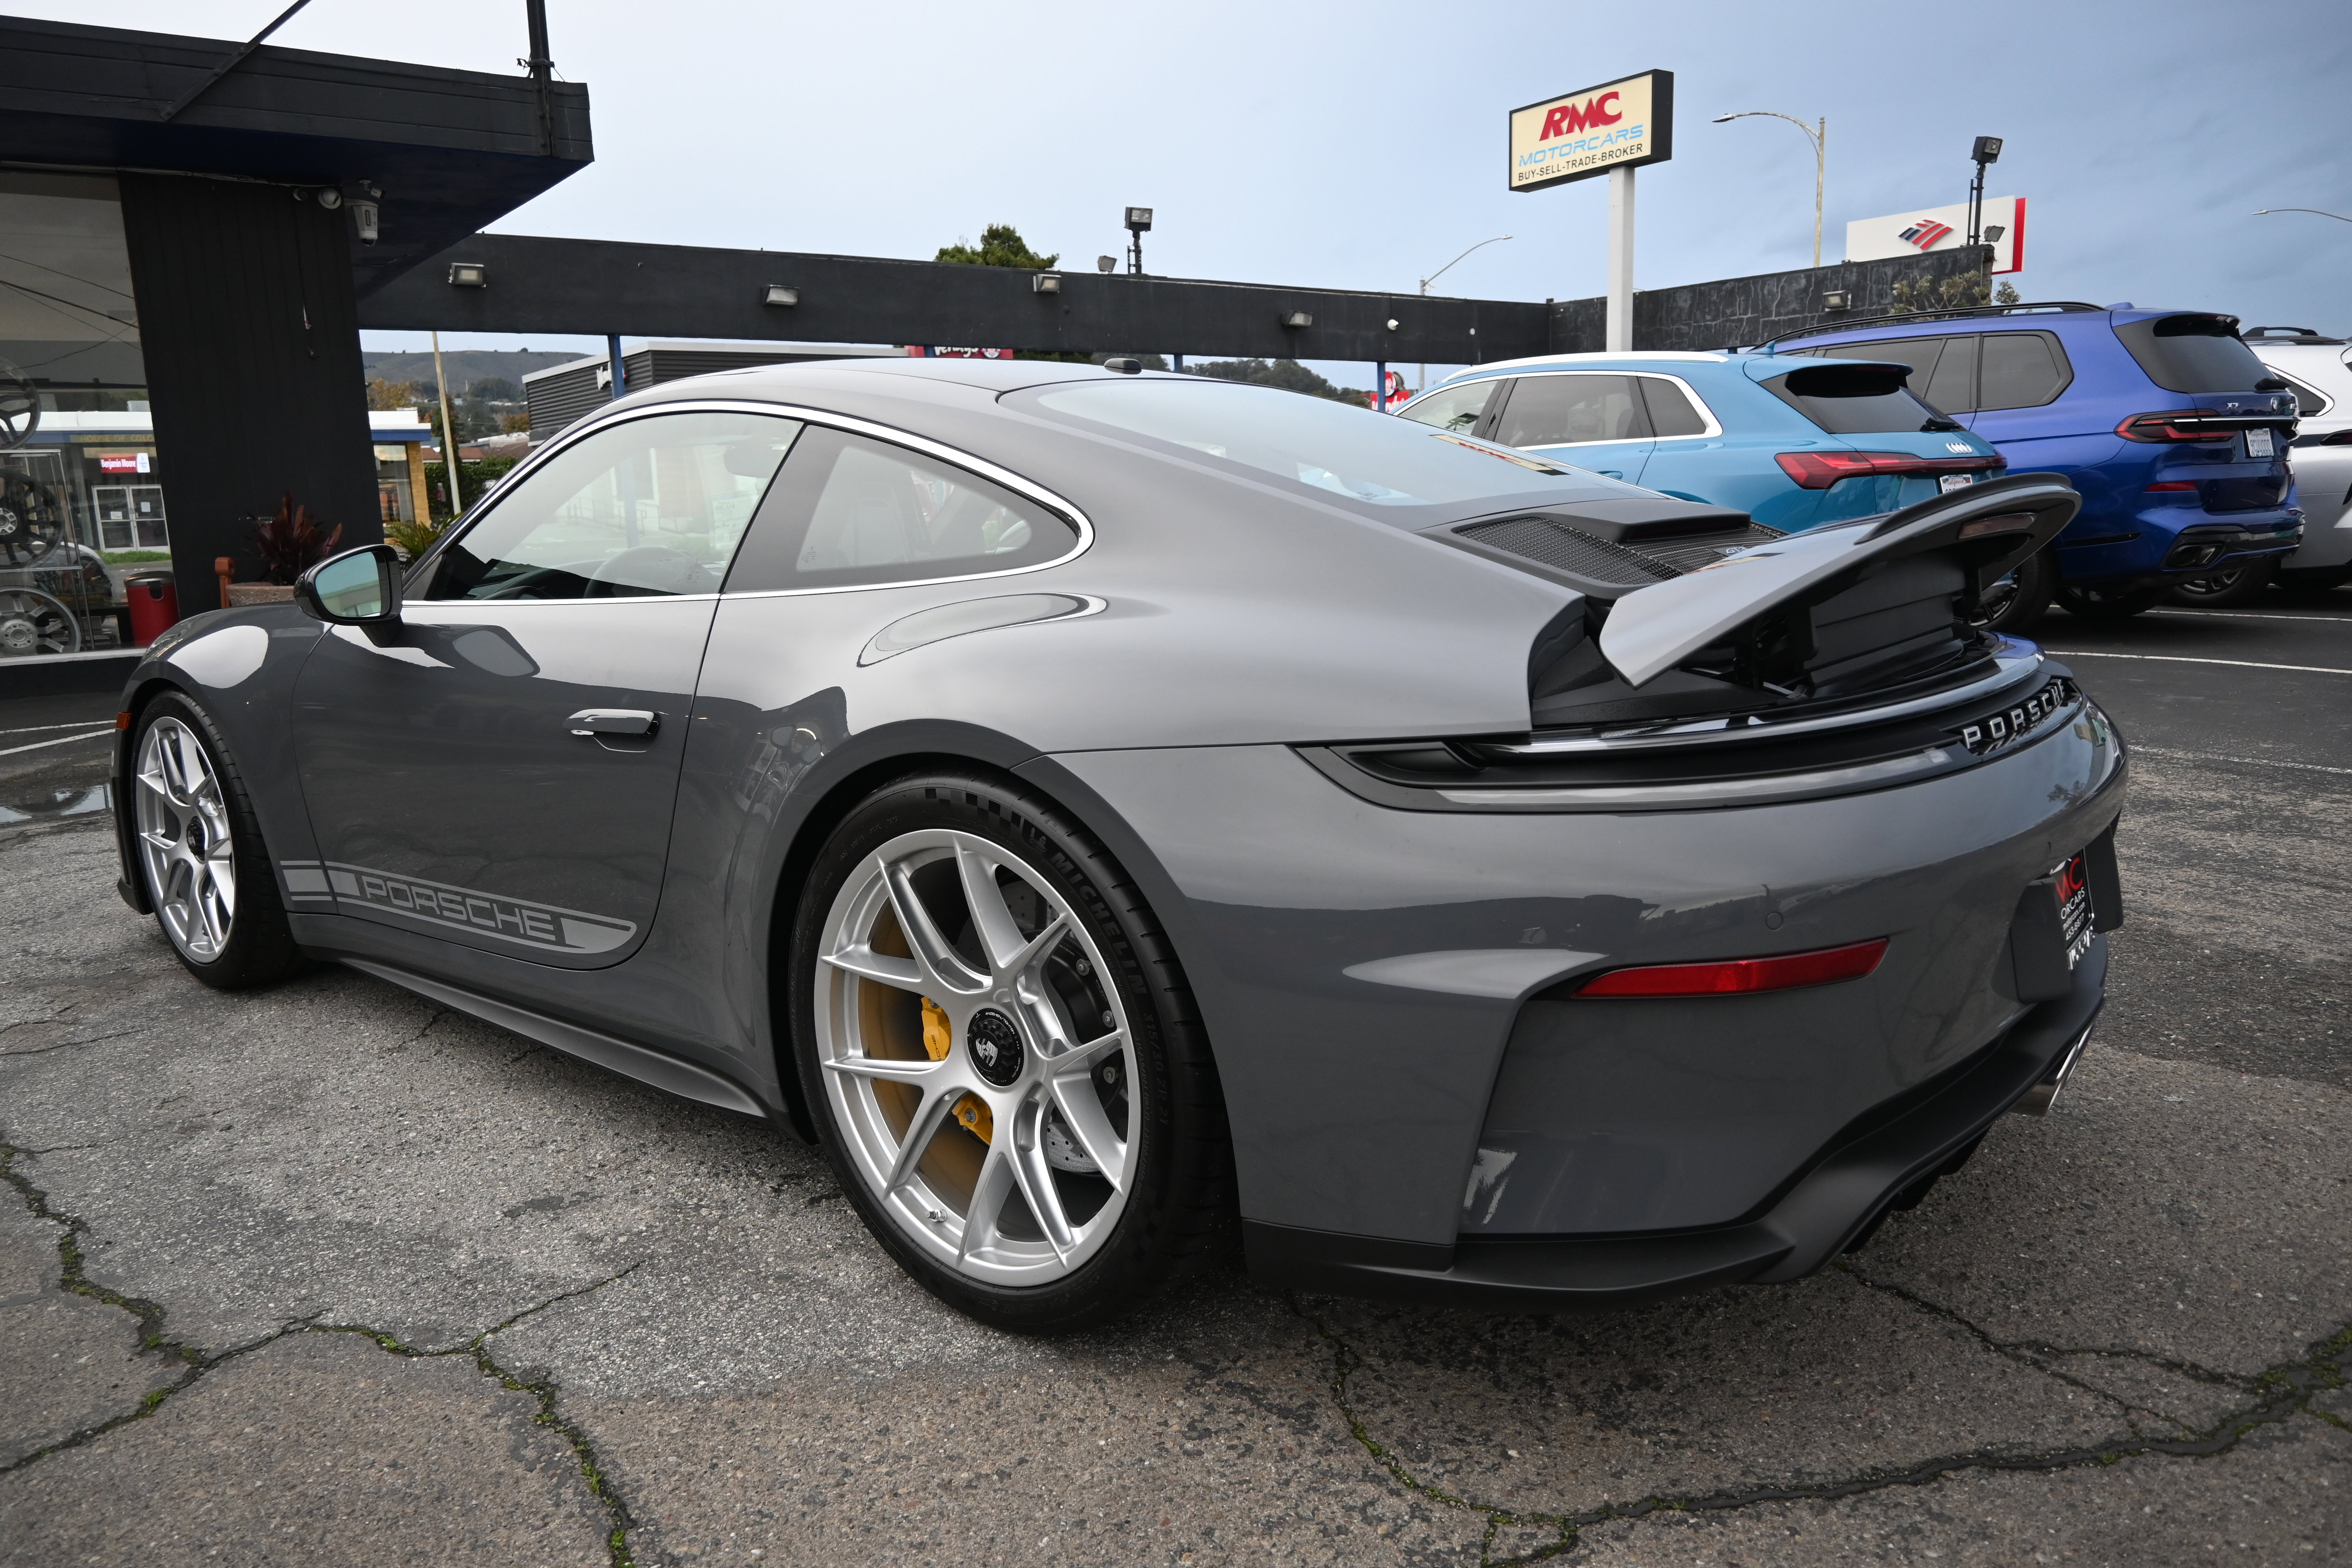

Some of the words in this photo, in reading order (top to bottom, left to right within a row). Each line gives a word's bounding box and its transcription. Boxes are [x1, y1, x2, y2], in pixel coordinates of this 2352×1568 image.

[1539, 91, 1622, 141] RMC
[1519, 124, 1644, 166] MOTORCARS
[1519, 143, 1643, 181] BUY-SELL-TRADE-BROKER
[101, 458, 121, 470] Benjamin
[121, 458, 136, 468] Moore
[1963, 679, 2065, 749] PORSCHE
[361, 875, 556, 941] PORSCHE
[1050, 851, 1148, 994] MICHELIN
[1143, 1013, 1164, 1072] 315/30
